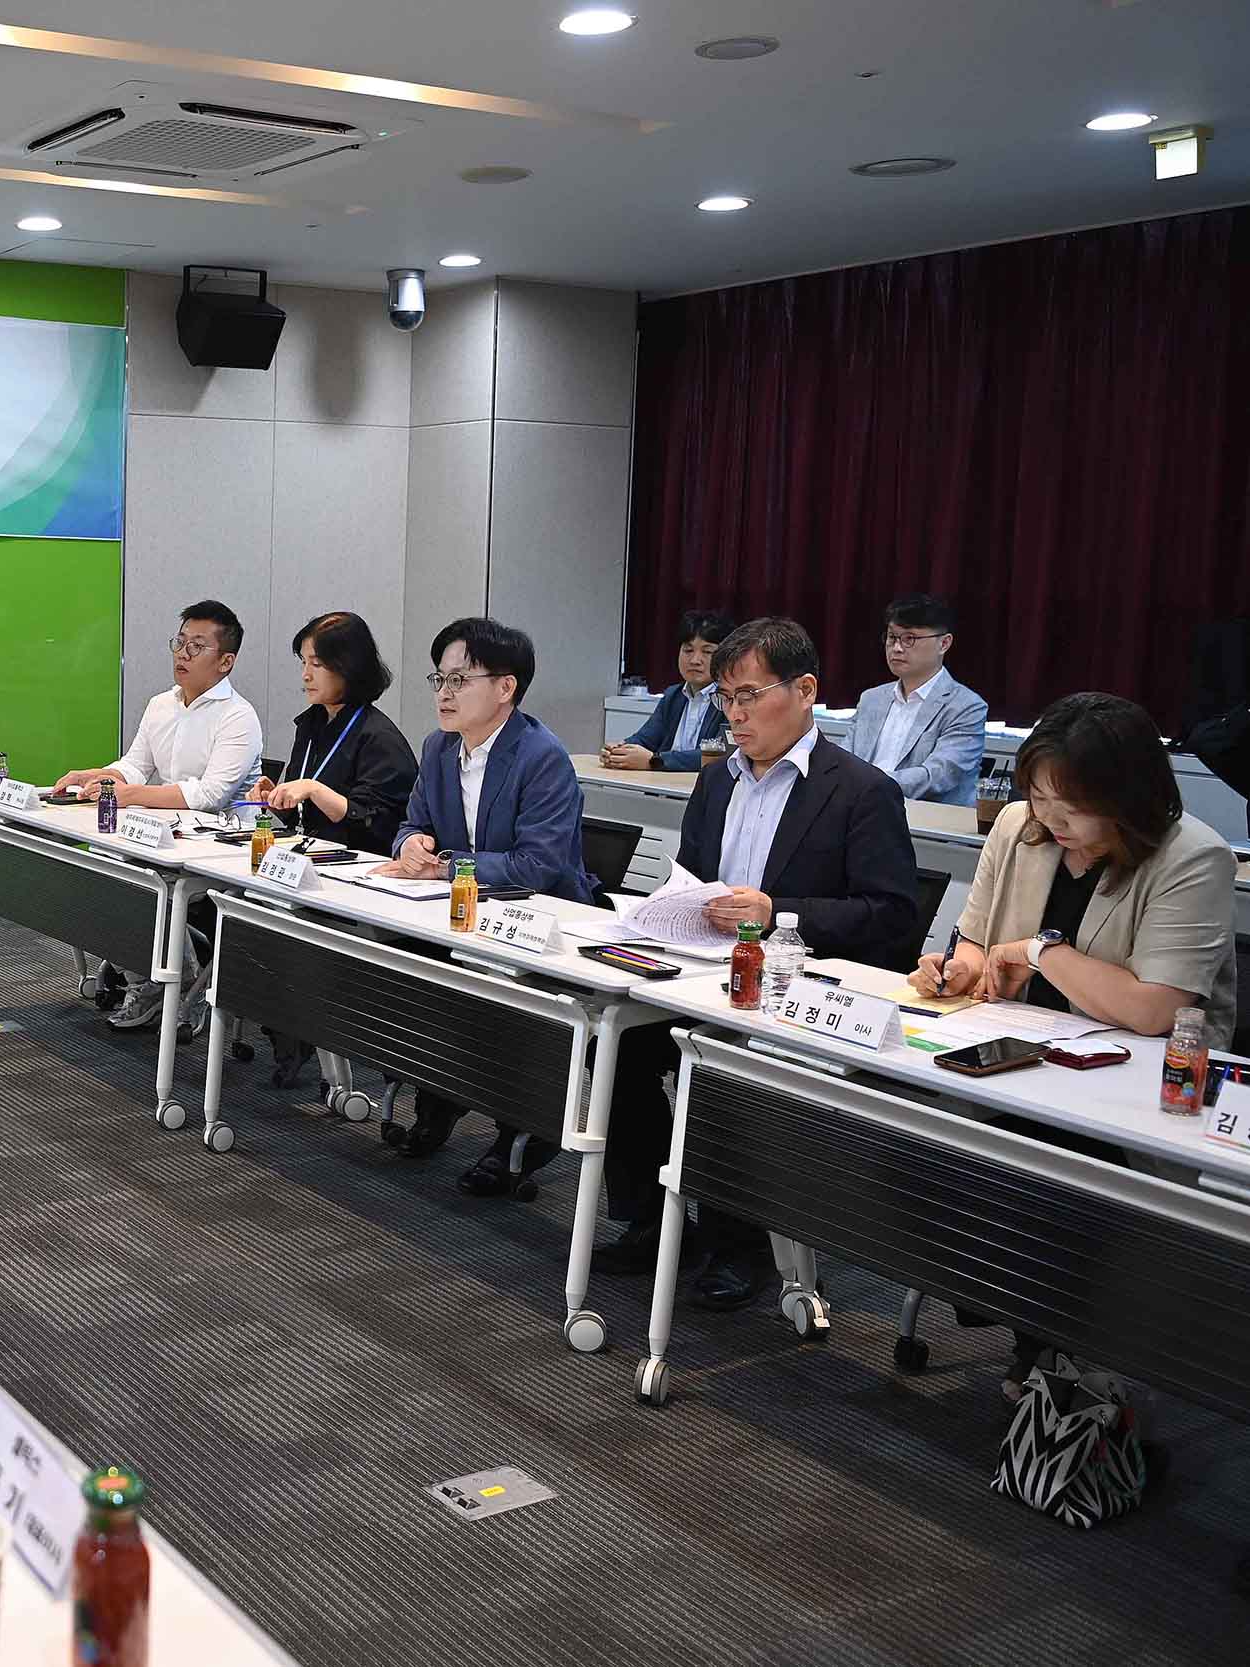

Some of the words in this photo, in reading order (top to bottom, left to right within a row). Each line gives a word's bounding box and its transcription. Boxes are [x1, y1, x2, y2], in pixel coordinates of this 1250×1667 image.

[502, 907, 535, 921] 산업통상부
[784, 1000, 843, 1032] 김정미
[854, 1023, 872, 1037] 이사
